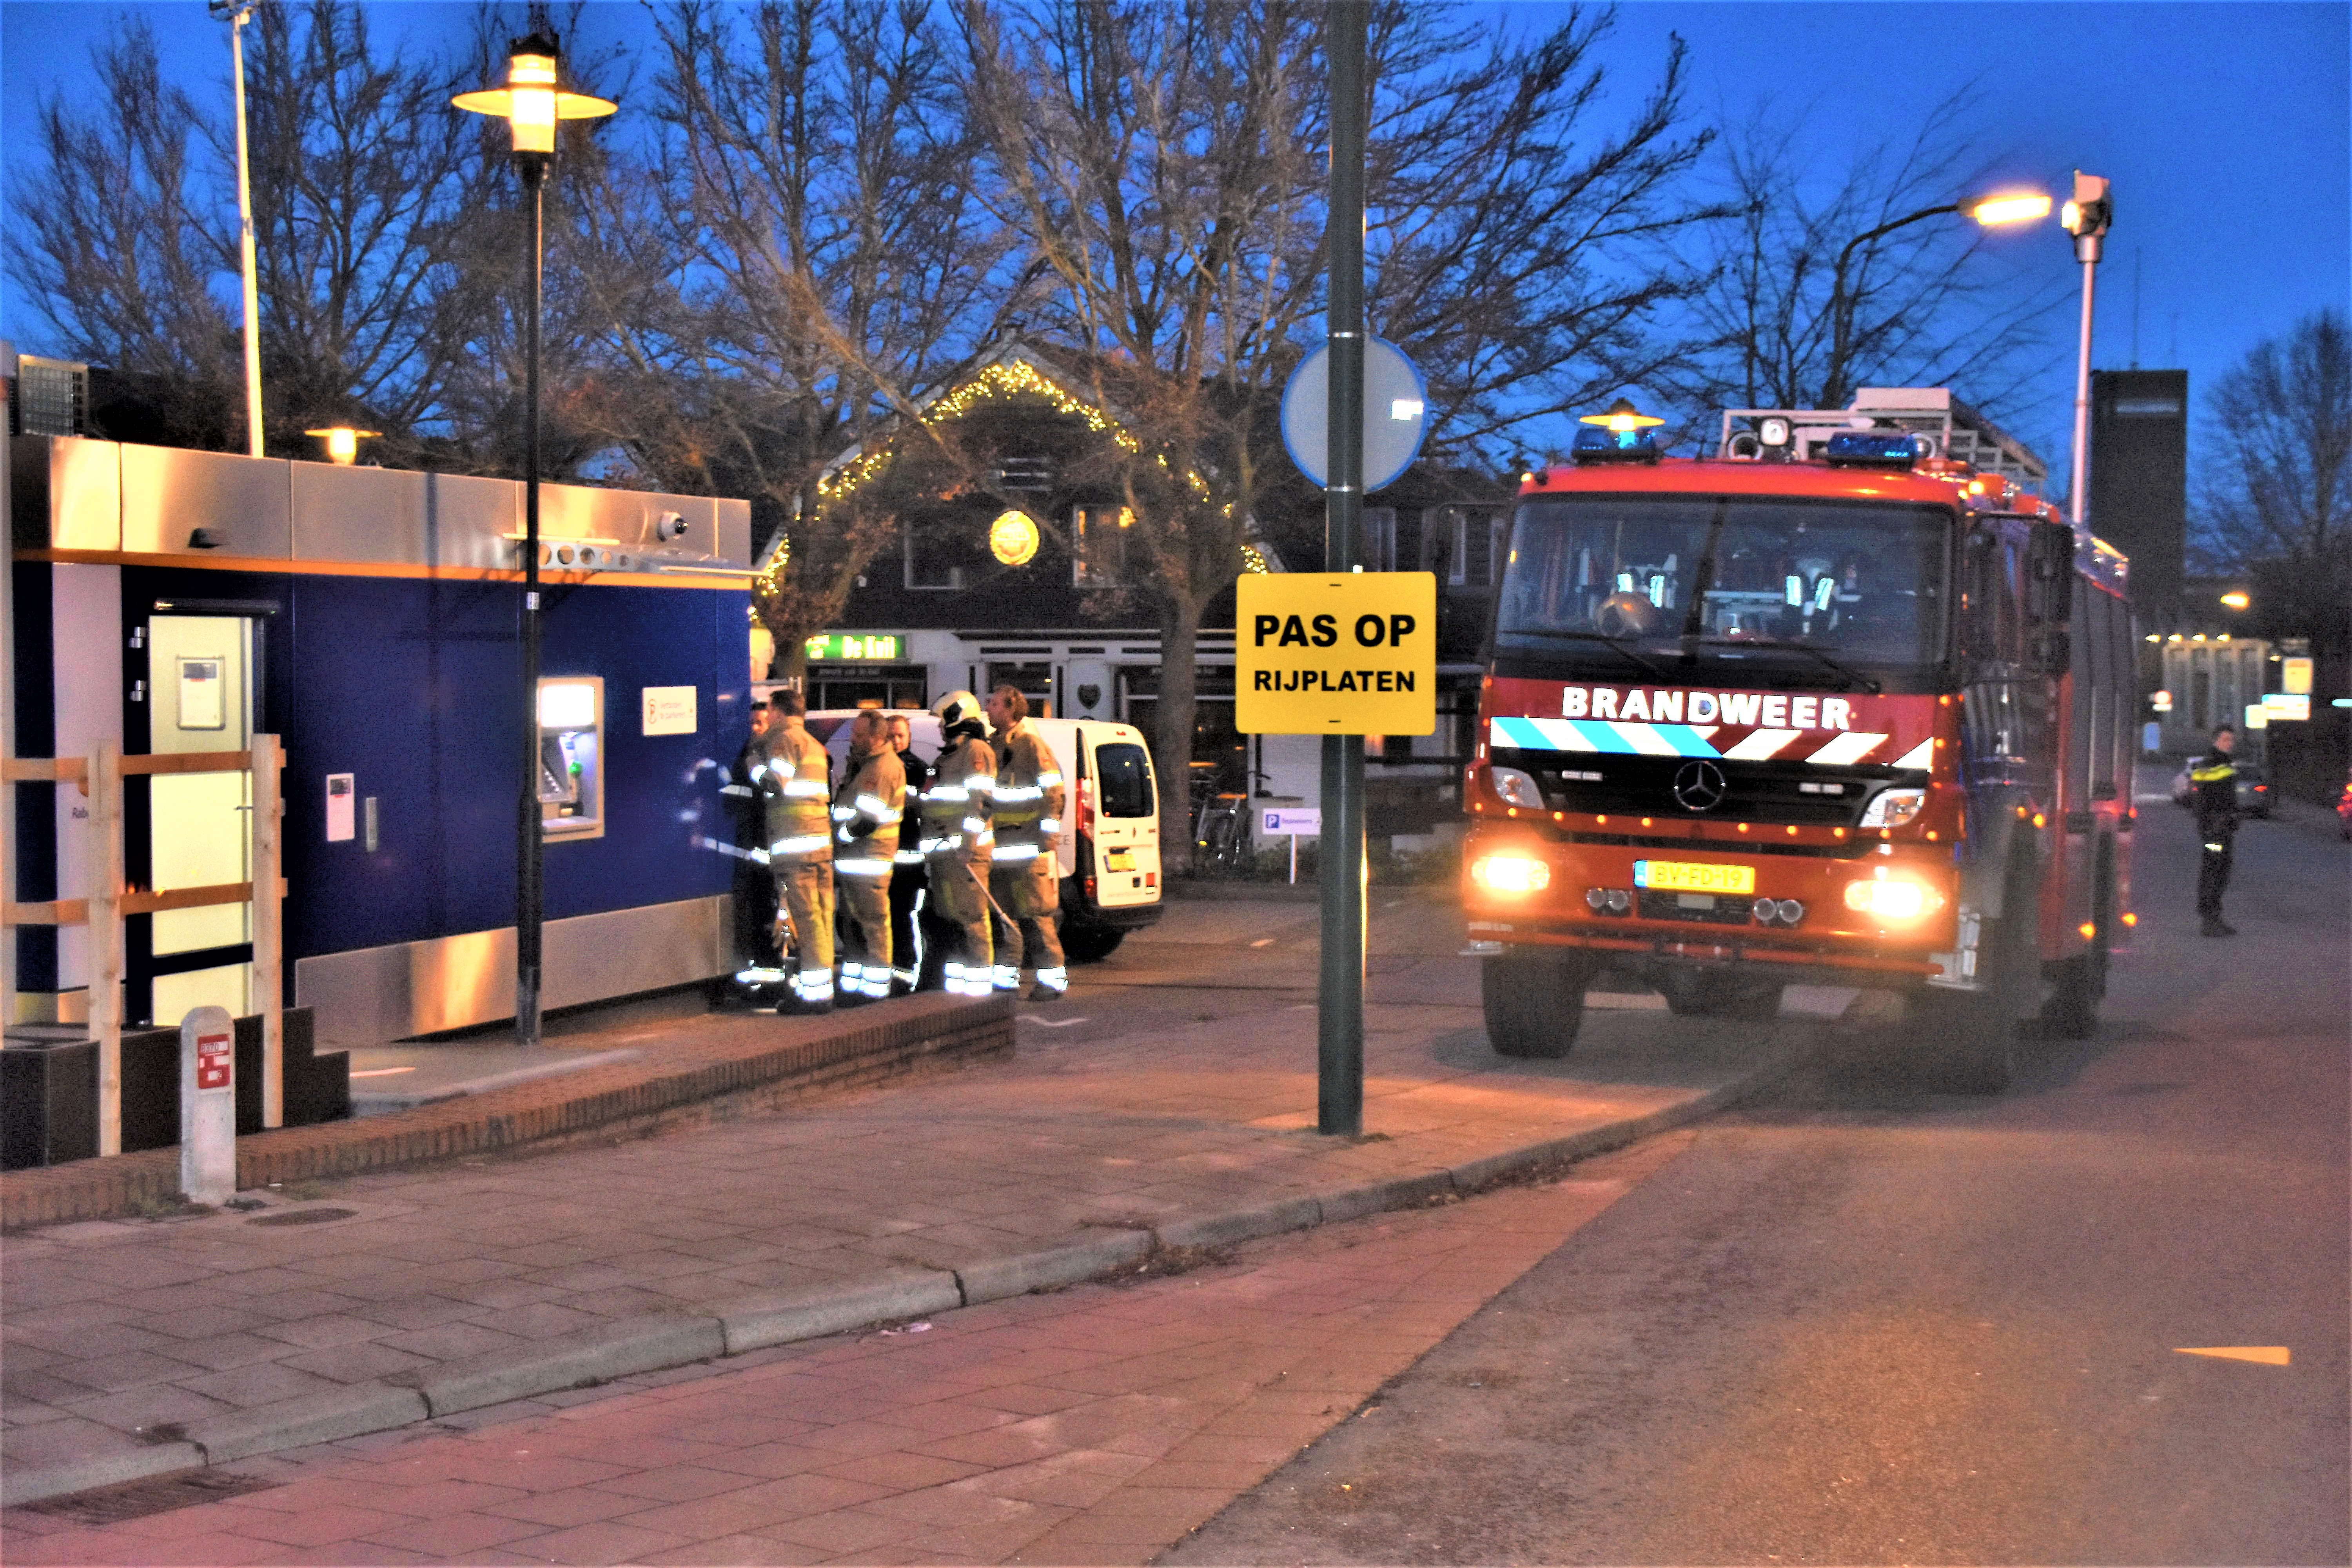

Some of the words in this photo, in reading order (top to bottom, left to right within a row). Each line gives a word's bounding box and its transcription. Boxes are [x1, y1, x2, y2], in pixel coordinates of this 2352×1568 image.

[1254, 614, 1338, 647] PAS
[1355, 614, 1416, 647] OP
[1254, 670, 1415, 692] RIJPLATEN
[1562, 686, 1851, 730] BRANDWEER
[1655, 865, 1743, 888] BV-FD-19
